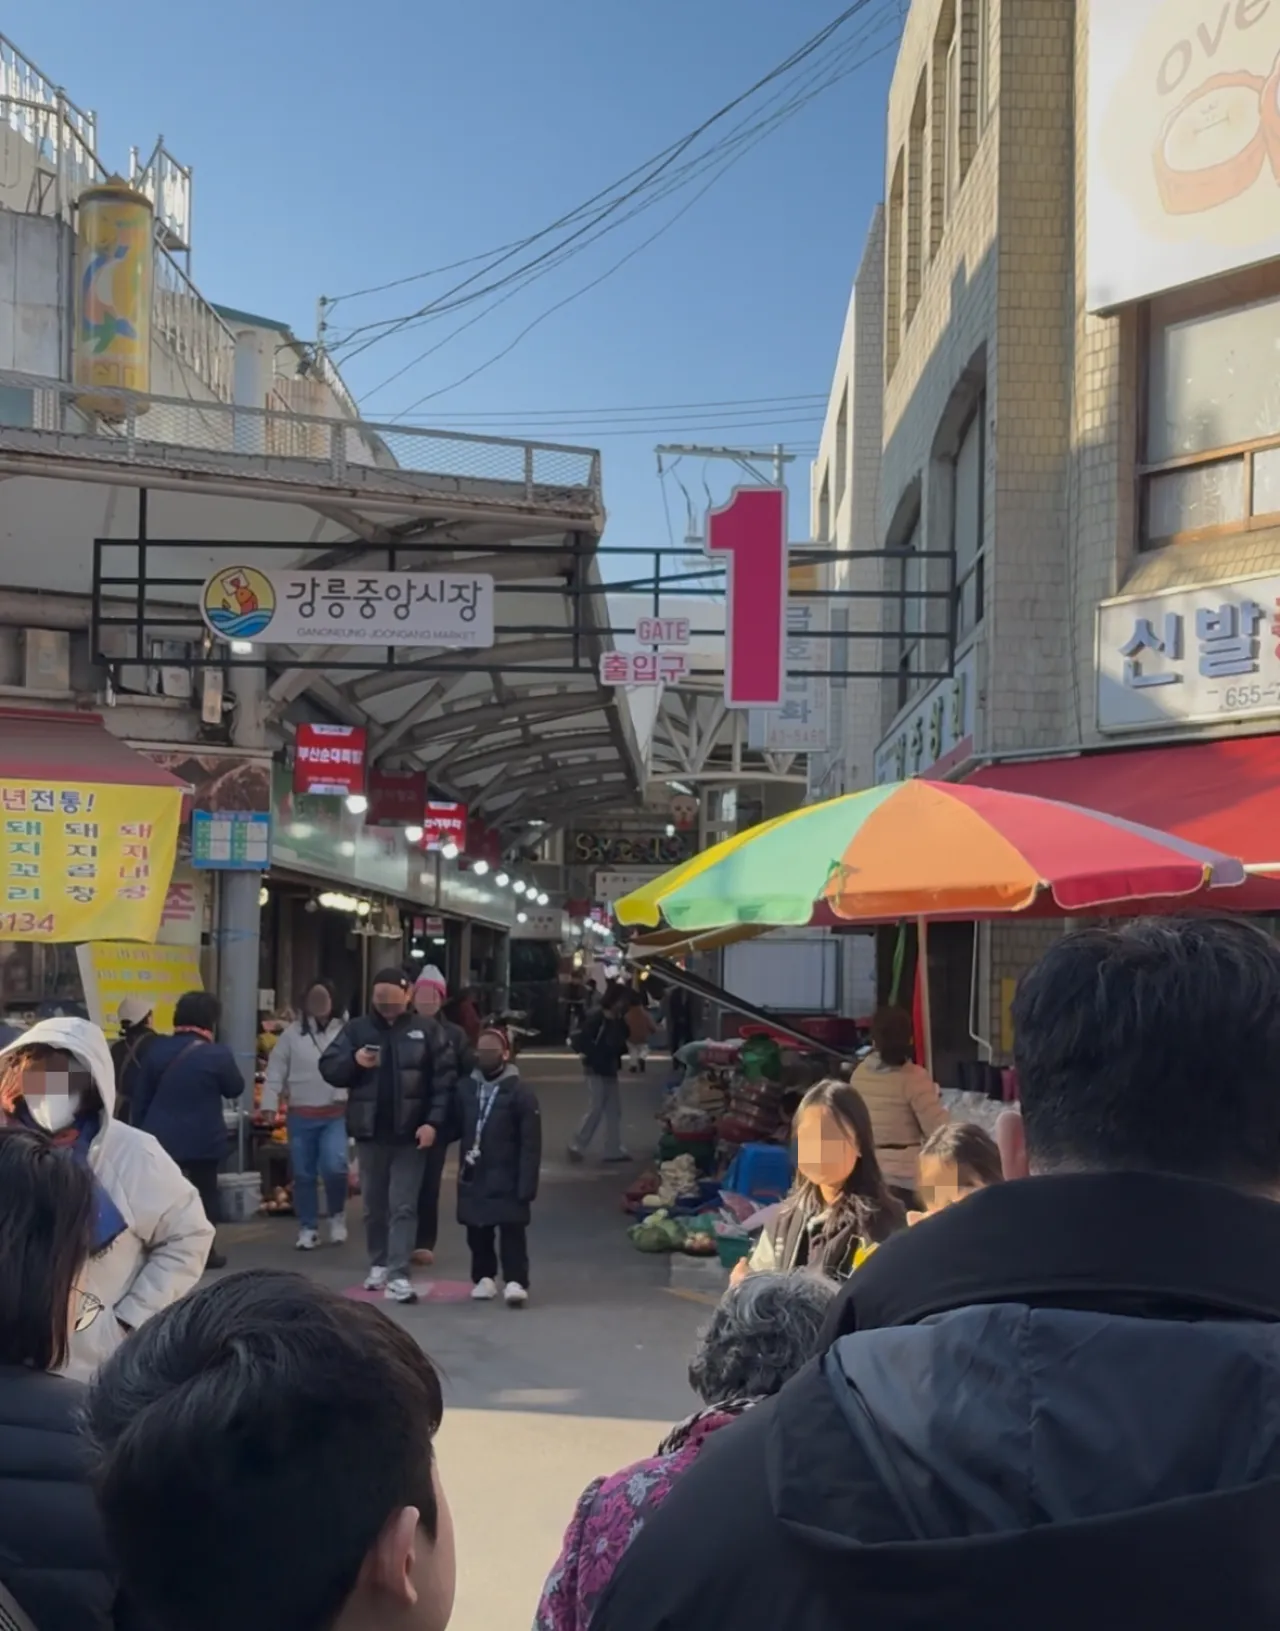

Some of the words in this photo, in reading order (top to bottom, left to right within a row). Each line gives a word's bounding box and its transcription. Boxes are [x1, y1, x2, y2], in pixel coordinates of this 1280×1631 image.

[286, 576, 483, 622] 강릉중앙시장
[707, 489, 783, 704] 1
[433, 631, 476, 640] MARKET
[638, 620, 688, 641] GATE
[1118, 596, 1280, 690] 신발
[604, 653, 686, 683] 출입구
[3, 787, 95, 814] 년전통!
